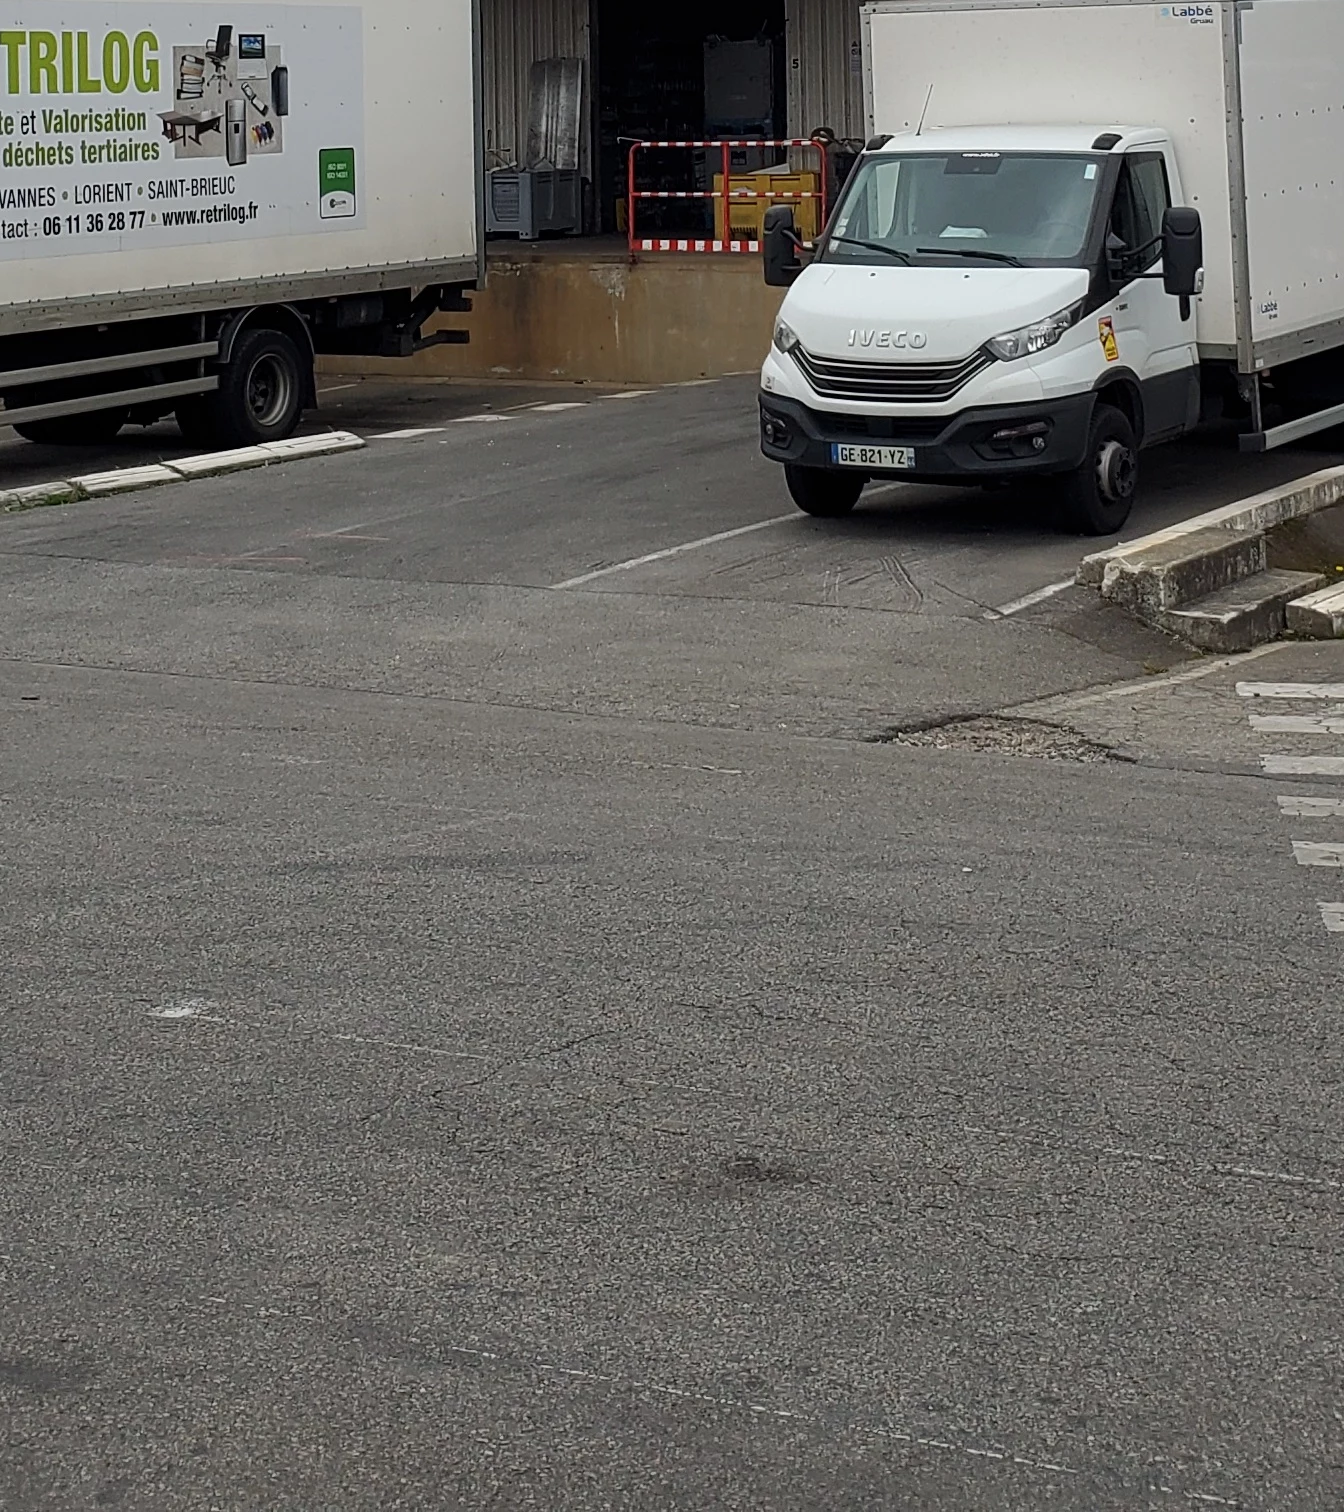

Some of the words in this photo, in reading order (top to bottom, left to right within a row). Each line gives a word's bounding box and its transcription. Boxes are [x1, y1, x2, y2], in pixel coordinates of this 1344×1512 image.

[1172, 5, 1213, 16] Labbé
[791, 58, 799, 69] 5
[20, 110, 37, 135] et
[42, 107, 147, 135] Valorisation
[2, 140, 74, 168] déchets
[80, 137, 160, 165] tertiaires
[74, 182, 133, 205] LORIENT
[148, 176, 236, 200] SAINT-BRIEUC
[42, 216, 61, 236] 06
[66, 214, 80, 234] 11
[86, 213, 104, 232] 36
[108, 211, 125, 231] 28
[129, 210, 145, 229] 77
[162, 201, 258, 226] www.retrilog.fr
[847, 329, 927, 349] IVECO
